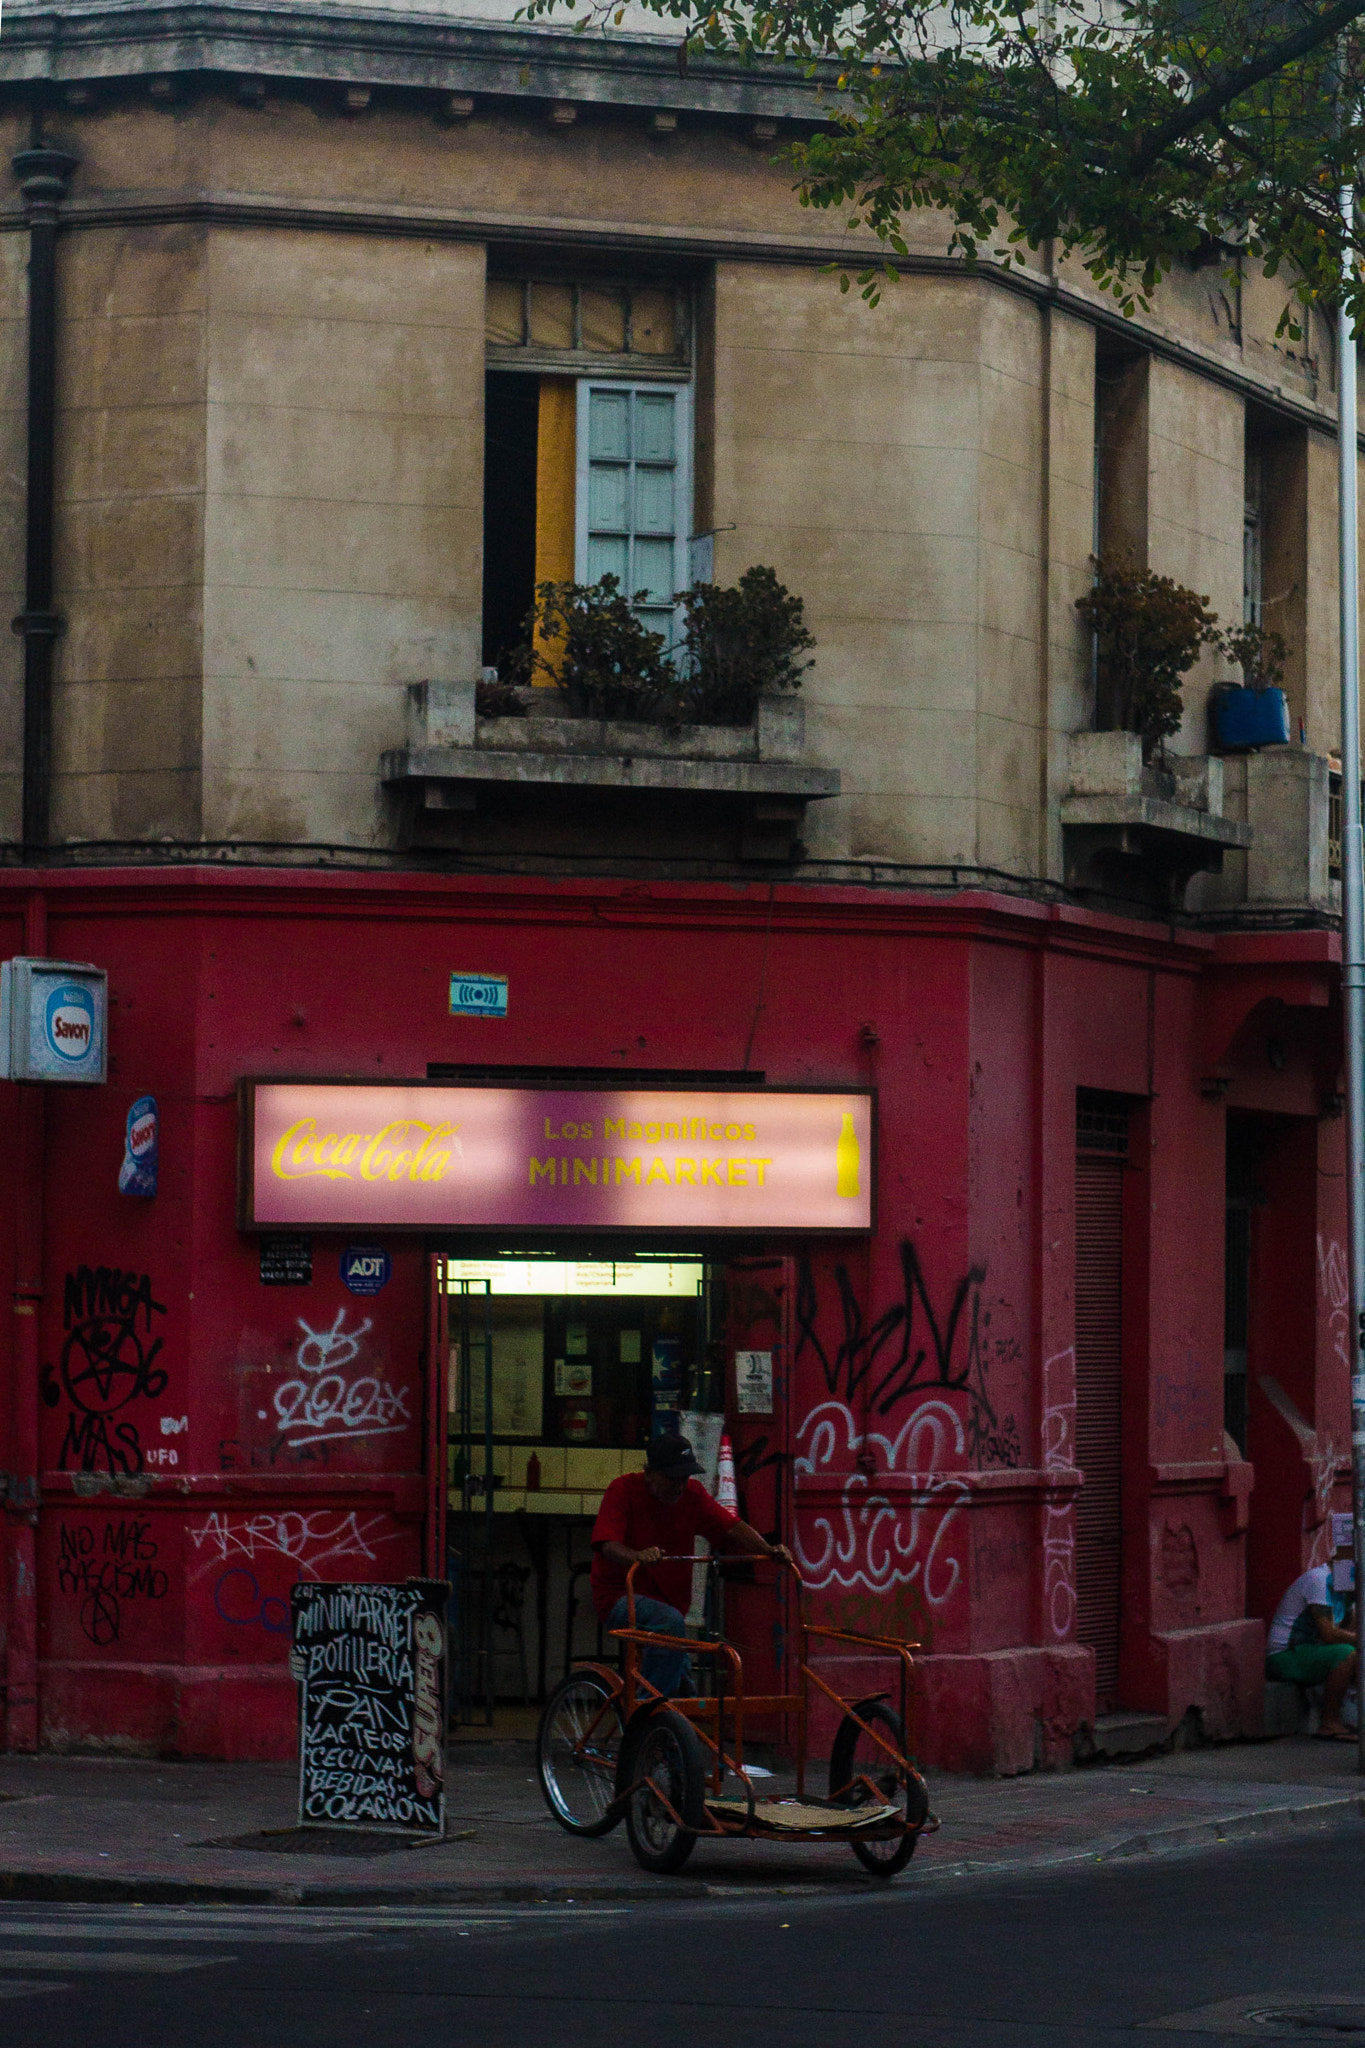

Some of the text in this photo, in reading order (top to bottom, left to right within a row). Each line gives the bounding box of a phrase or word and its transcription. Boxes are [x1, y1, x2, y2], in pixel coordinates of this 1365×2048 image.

[55, 1016, 90, 1044] Savory
[544, 1116, 756, 1144] Los Magnificos
[271, 1117, 462, 1182] Coca-Cola
[528, 1156, 772, 1187] MINIMARKET
[347, 1256, 385, 1277] ADT
[146, 1448, 179, 1466] UFO
[60, 1523, 95, 1557] NO
[295, 1593, 418, 1651] MINIMARKET
